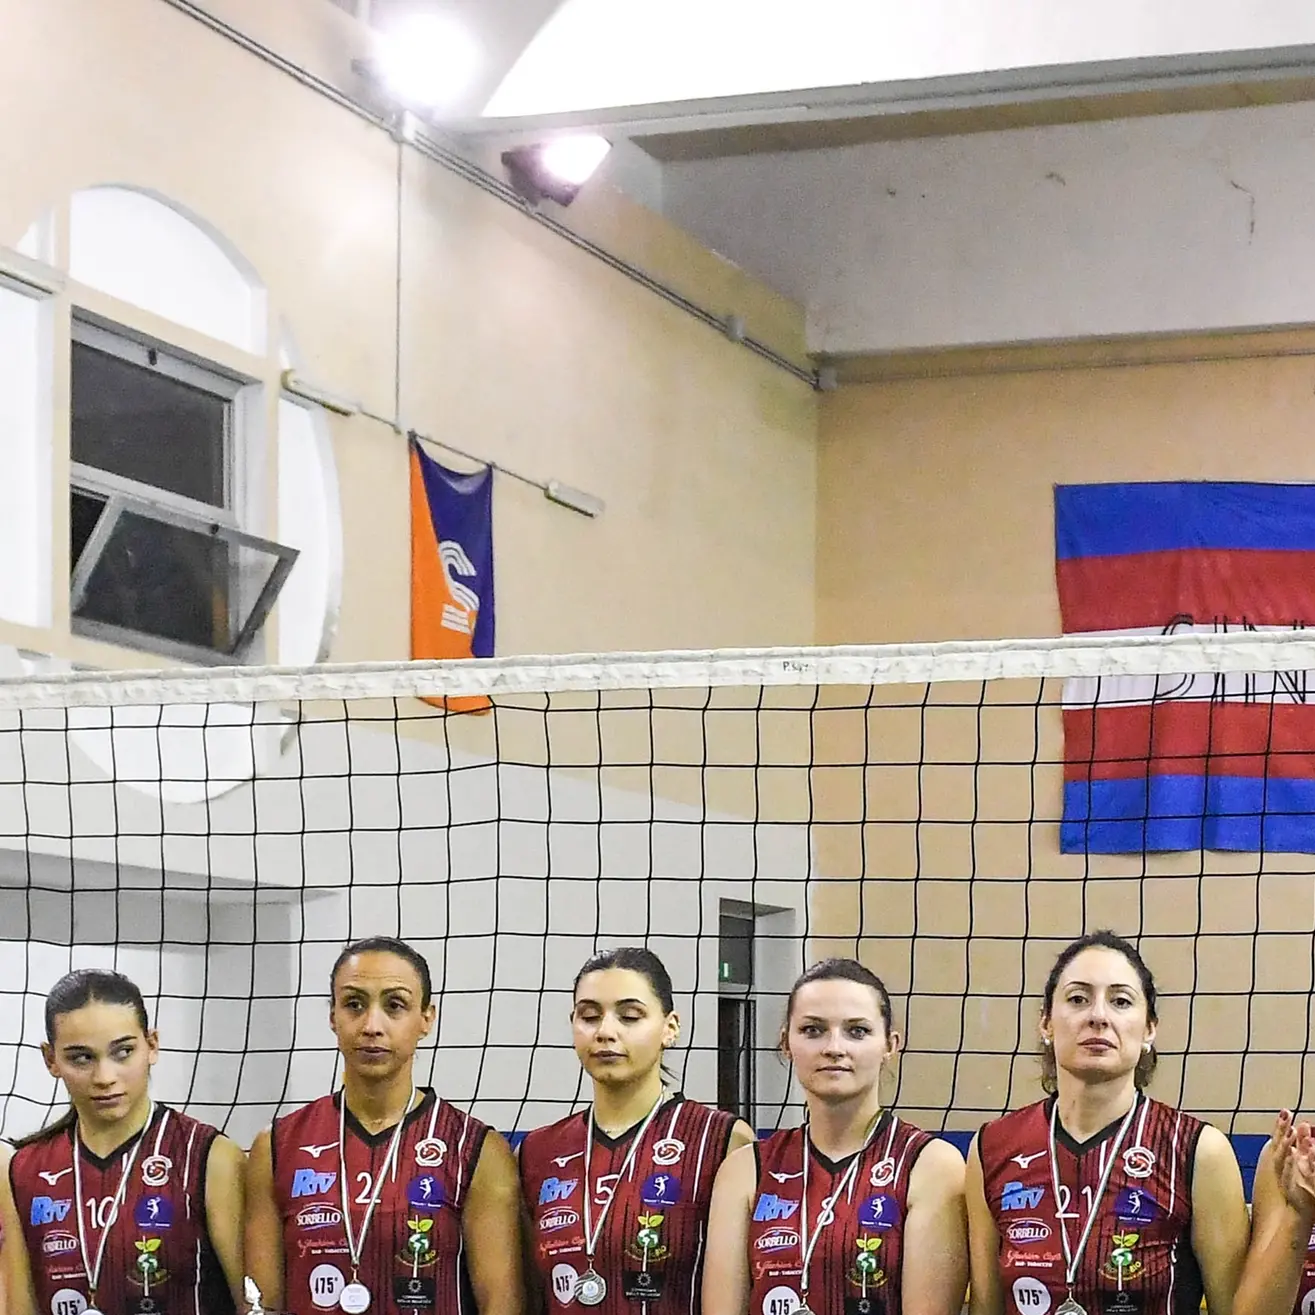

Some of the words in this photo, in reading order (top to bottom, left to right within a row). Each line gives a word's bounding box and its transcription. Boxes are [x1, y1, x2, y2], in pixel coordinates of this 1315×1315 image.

[355, 1172, 381, 1204] 2
[594, 1174, 620, 1205] 5
[86, 1196, 119, 1230] 10
